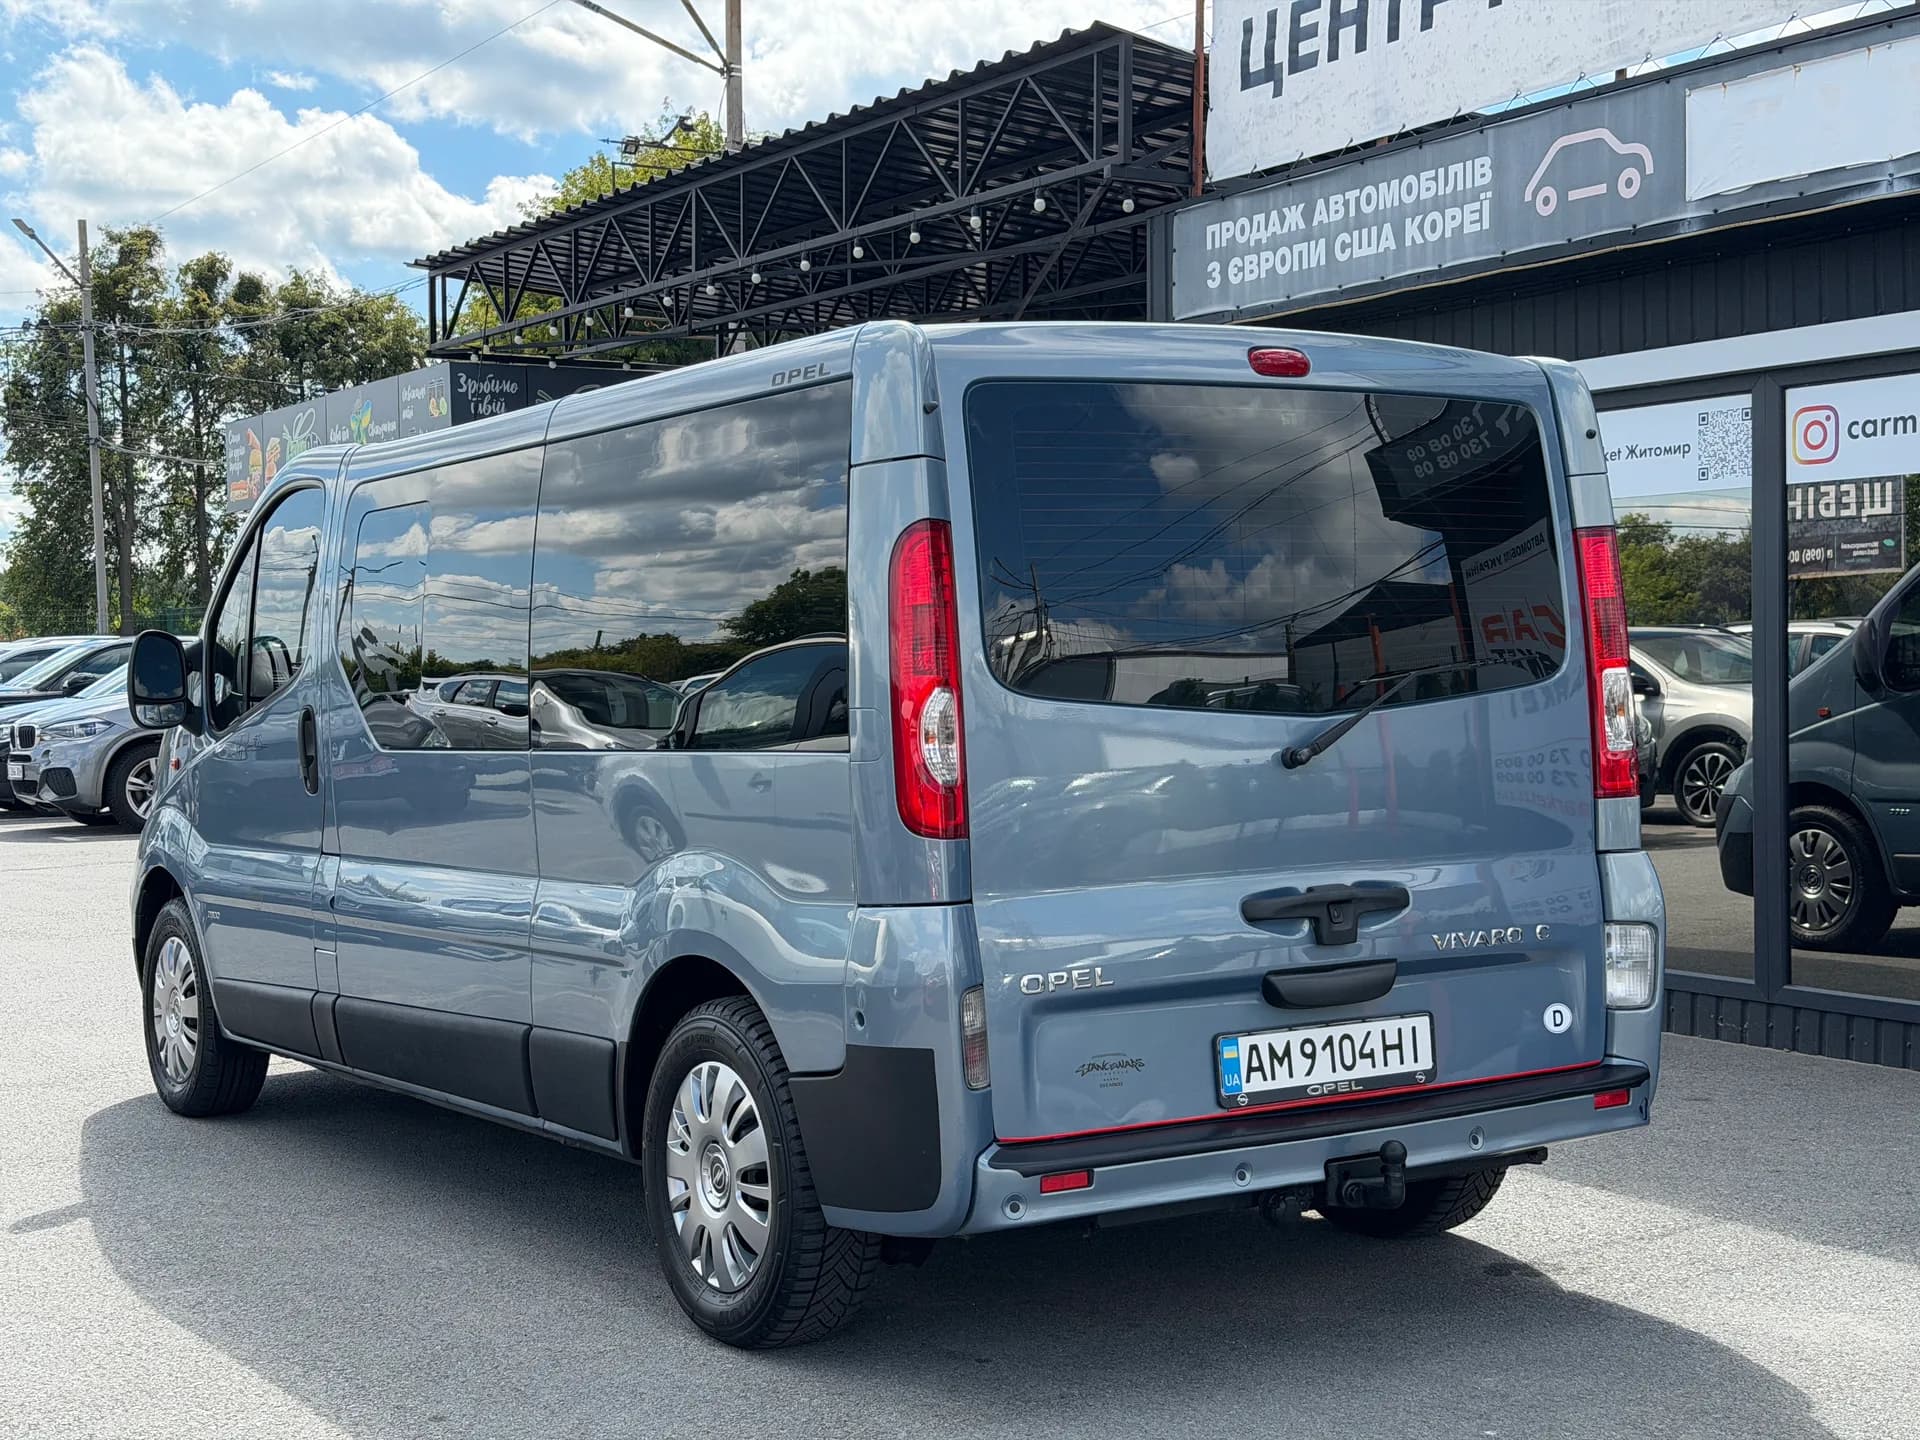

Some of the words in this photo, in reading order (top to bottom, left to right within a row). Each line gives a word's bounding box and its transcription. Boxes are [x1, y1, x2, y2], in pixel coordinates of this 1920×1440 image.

[1206, 202, 1306, 250] ПРОДАЖ
[1312, 155, 1493, 227] АВТОМОБІЛІВ
[1206, 260, 1221, 289] З
[1228, 238, 1326, 285] ЄВРОПИ
[1334, 222, 1397, 262] США
[1404, 191, 1493, 247] КОРЕЇ
[457, 372, 519, 400] Зробимо
[771, 362, 831, 387] OPEL
[1625, 443, 1692, 460] Житомир
[1432, 927, 1523, 950] VIVARO
[1020, 967, 1115, 995] OPEL
[1552, 1010, 1563, 1027] D
[1225, 1073, 1240, 1087] UA
[1306, 1080, 1364, 1095] OPEL
